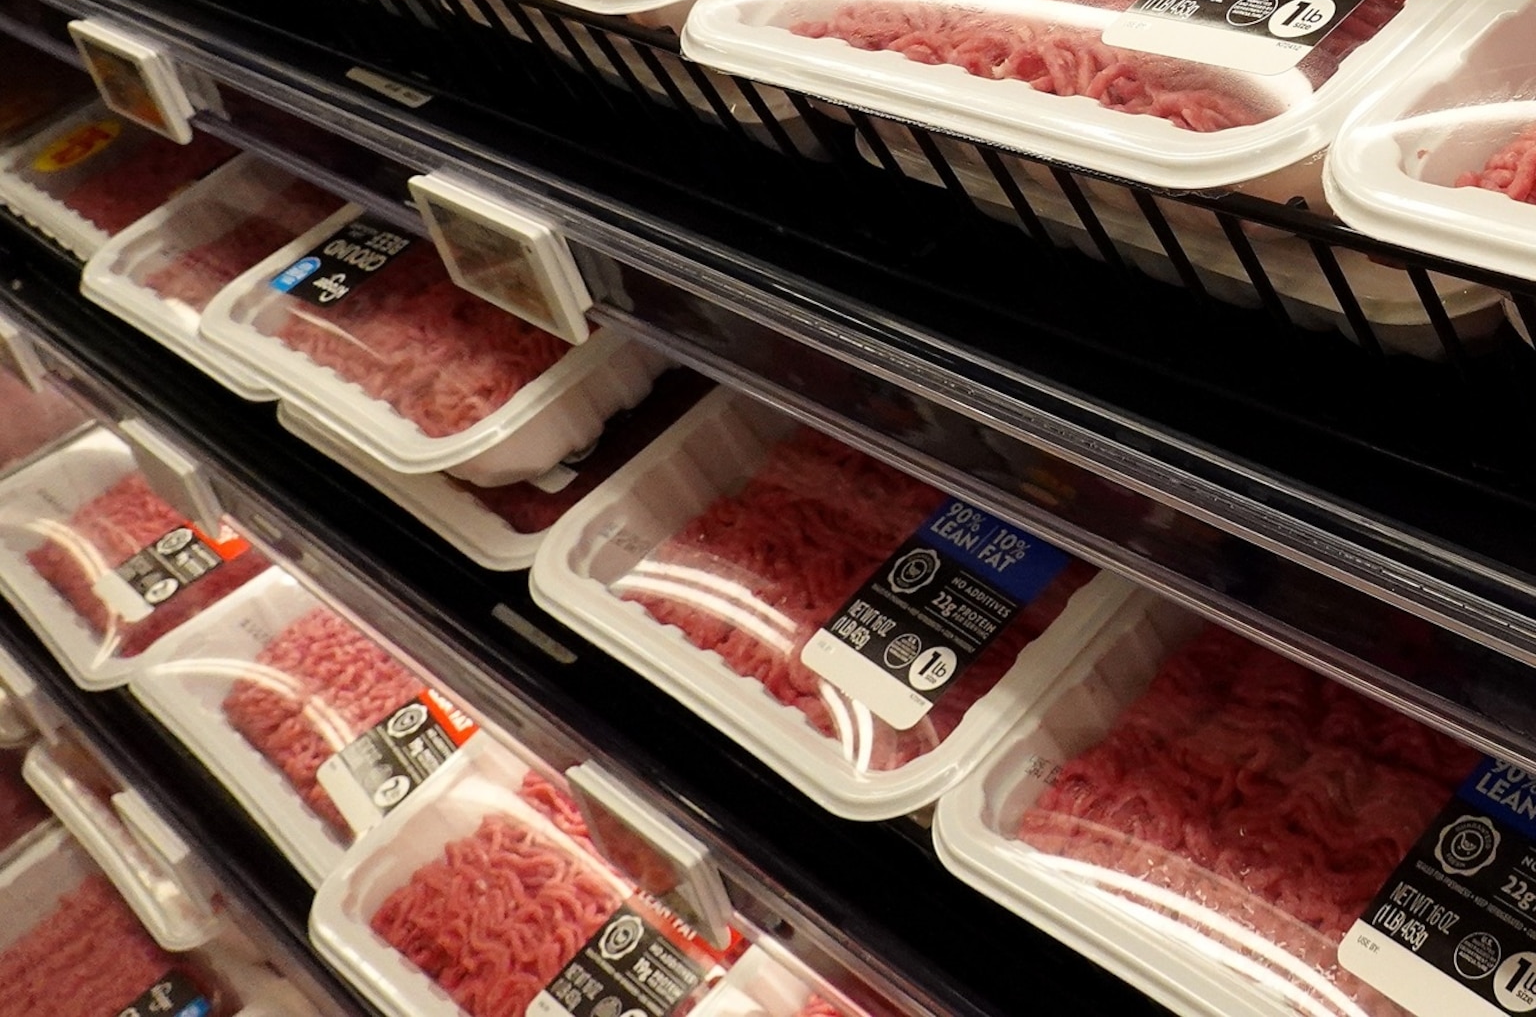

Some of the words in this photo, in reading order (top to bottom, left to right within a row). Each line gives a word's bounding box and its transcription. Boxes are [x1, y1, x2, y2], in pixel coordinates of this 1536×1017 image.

[1281, 1, 1312, 26] 1
[1301, 8, 1323, 23] lb
[1293, 22, 1312, 31] size
[322, 238, 388, 272] GROUND
[930, 516, 981, 552] LEAN
[977, 544, 1017, 573] FAT
[947, 501, 988, 532] 90%
[991, 528, 1032, 561] 10%
[931, 591, 958, 618] 22g
[957, 604, 998, 634] PROTEIN
[951, 576, 968, 591] NO
[965, 583, 1012, 620] ADDITIVES
[1390, 881, 1419, 911] NET
[1411, 893, 1435, 916] WT
[1500, 875, 1536, 911] 22g
[1429, 902, 1446, 926] 16
[1437, 909, 1461, 935] OZ
[1505, 957, 1532, 994] 1
[1515, 988, 1535, 1005] size
